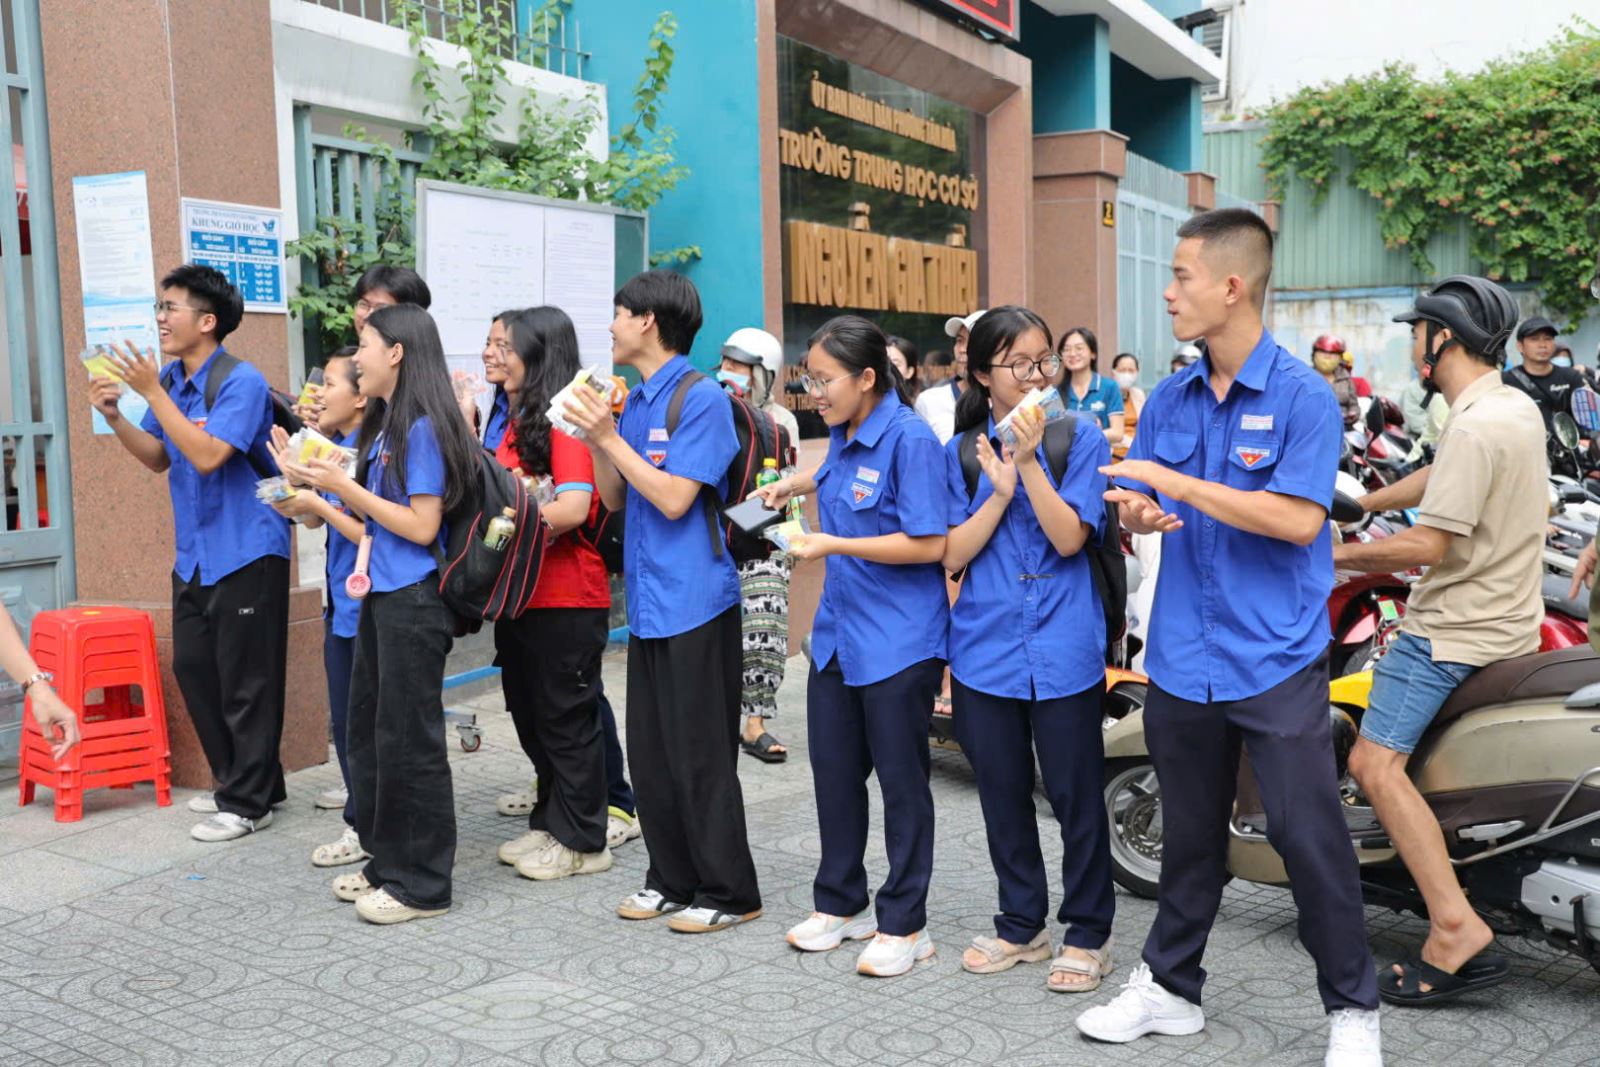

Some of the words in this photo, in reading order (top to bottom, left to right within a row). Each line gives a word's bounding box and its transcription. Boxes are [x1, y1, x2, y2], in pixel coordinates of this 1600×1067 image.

[779, 126, 851, 180] TRƯỜNG
[852, 150, 903, 192] TRUNG
[904, 164, 937, 208] HỌC
[938, 174, 960, 206] CƠ
[960, 174, 979, 211] SỞ
[192, 217, 224, 229] KHUNG
[790, 201, 889, 309] NGUYỄN
[888, 236, 926, 313] GIA
